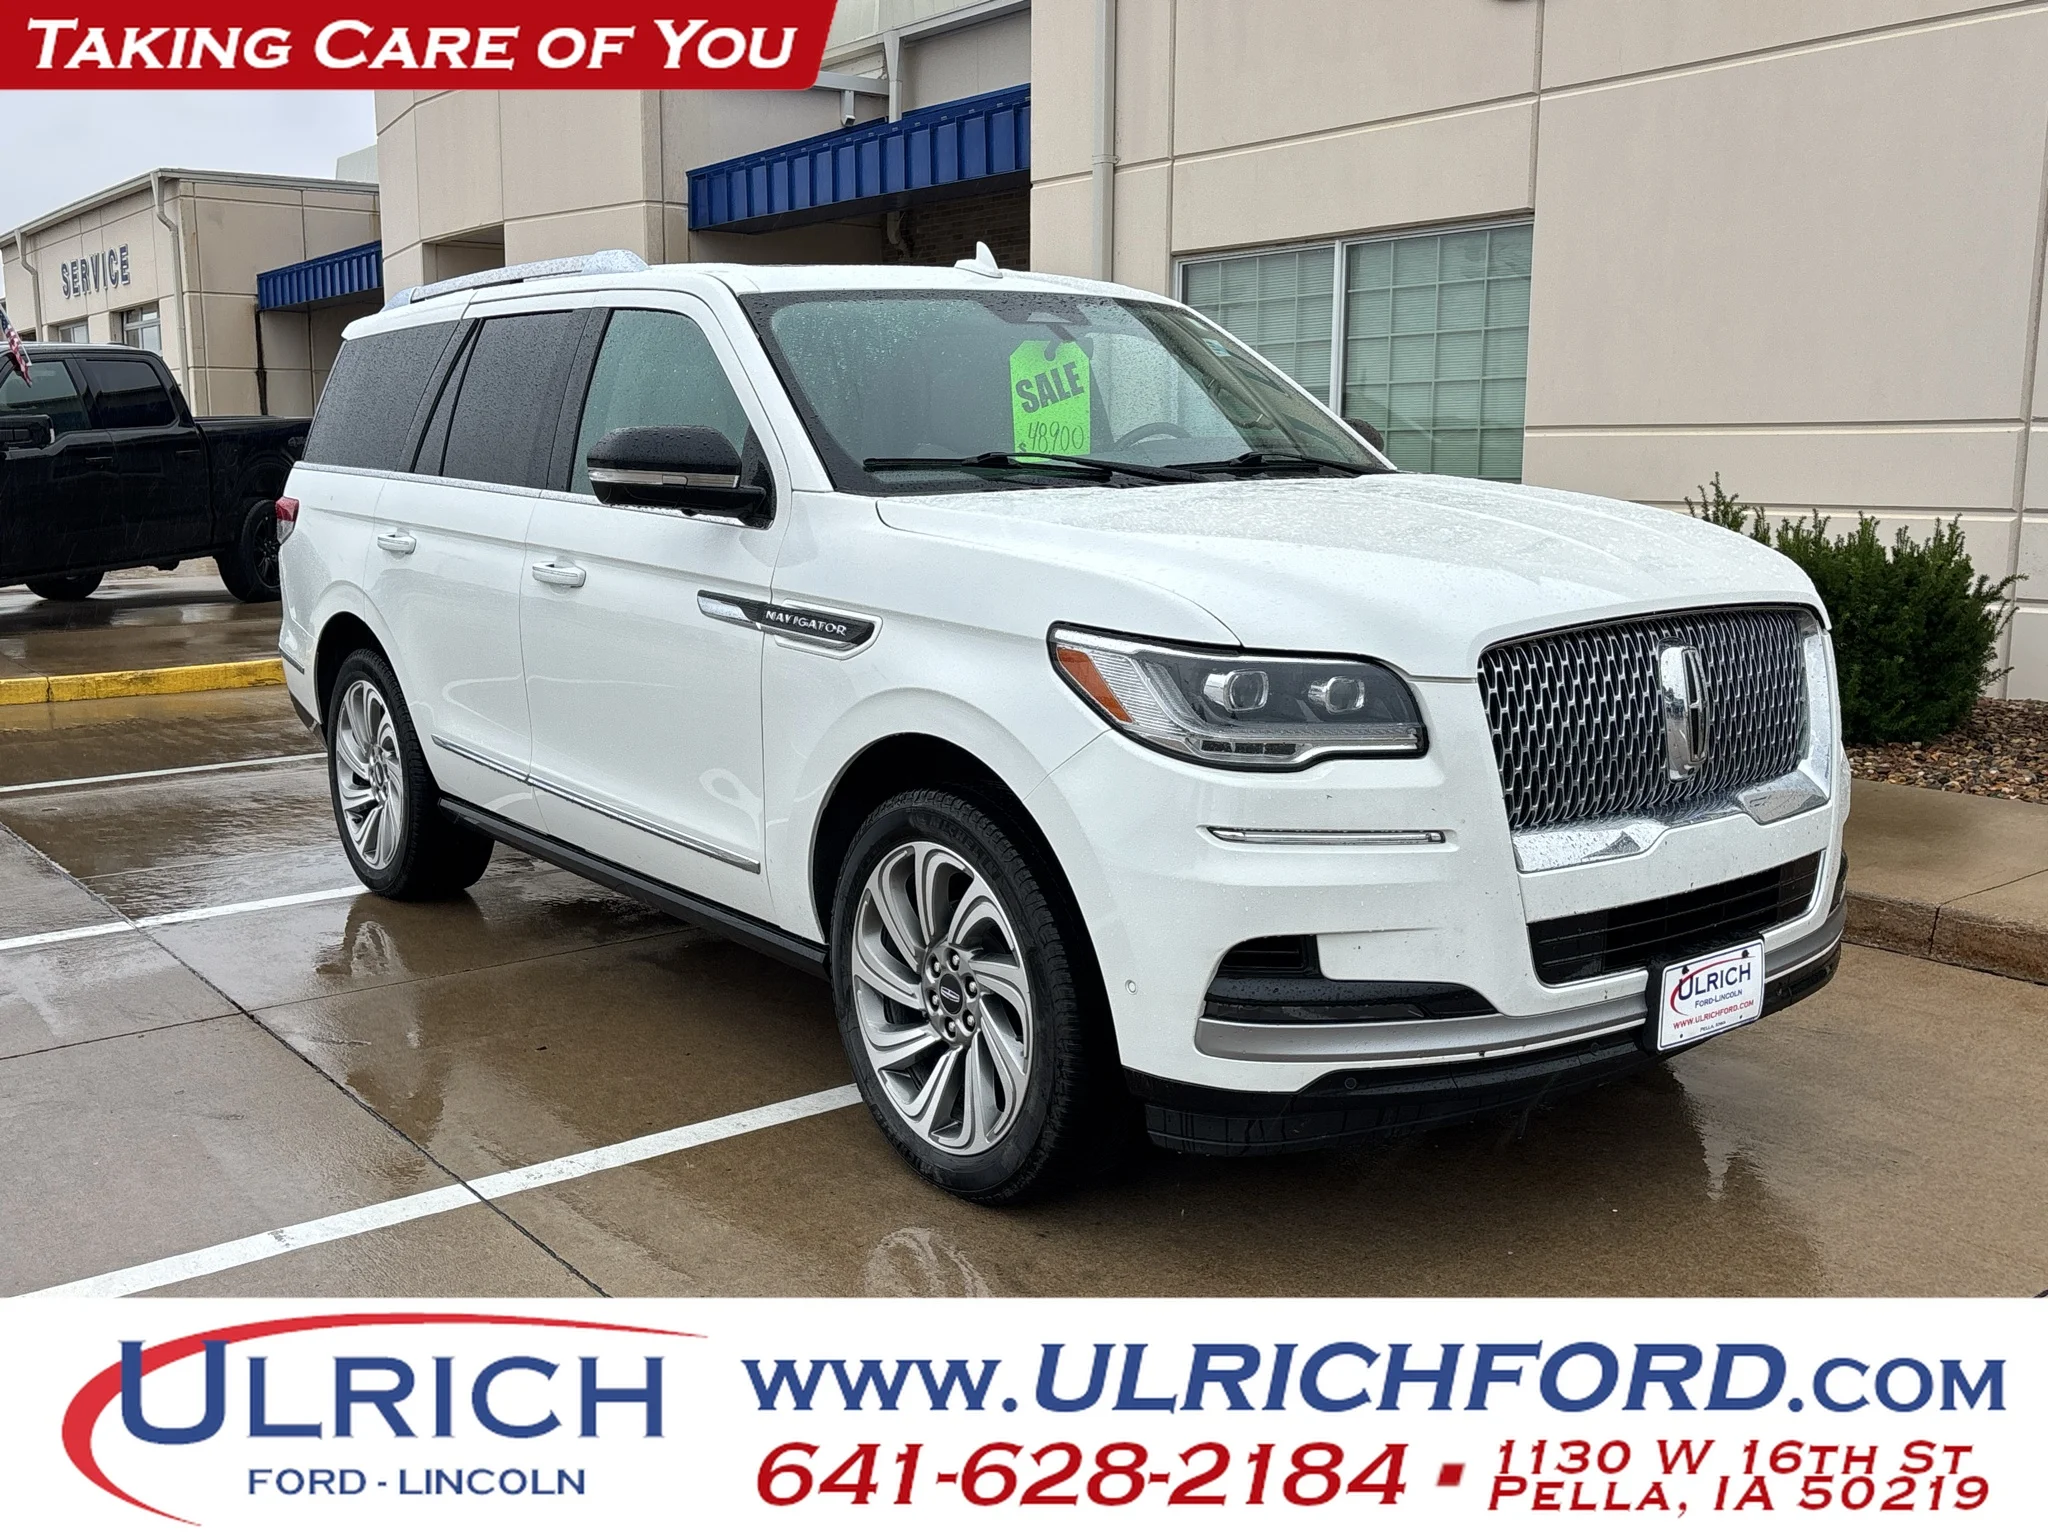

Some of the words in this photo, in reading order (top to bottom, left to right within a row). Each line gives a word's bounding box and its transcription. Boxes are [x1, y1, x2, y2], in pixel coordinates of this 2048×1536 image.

[61, 243, 131, 299] SERVICE
[1015, 361, 1085, 413] SALE
[765, 610, 848, 636] NAVIGATOR
[1679, 962, 1751, 1001] ULRICH
[1694, 989, 1743, 1009] FORD-LINCOLN
[1673, 999, 1754, 1030] WWW.ULRICHFORD.COM
